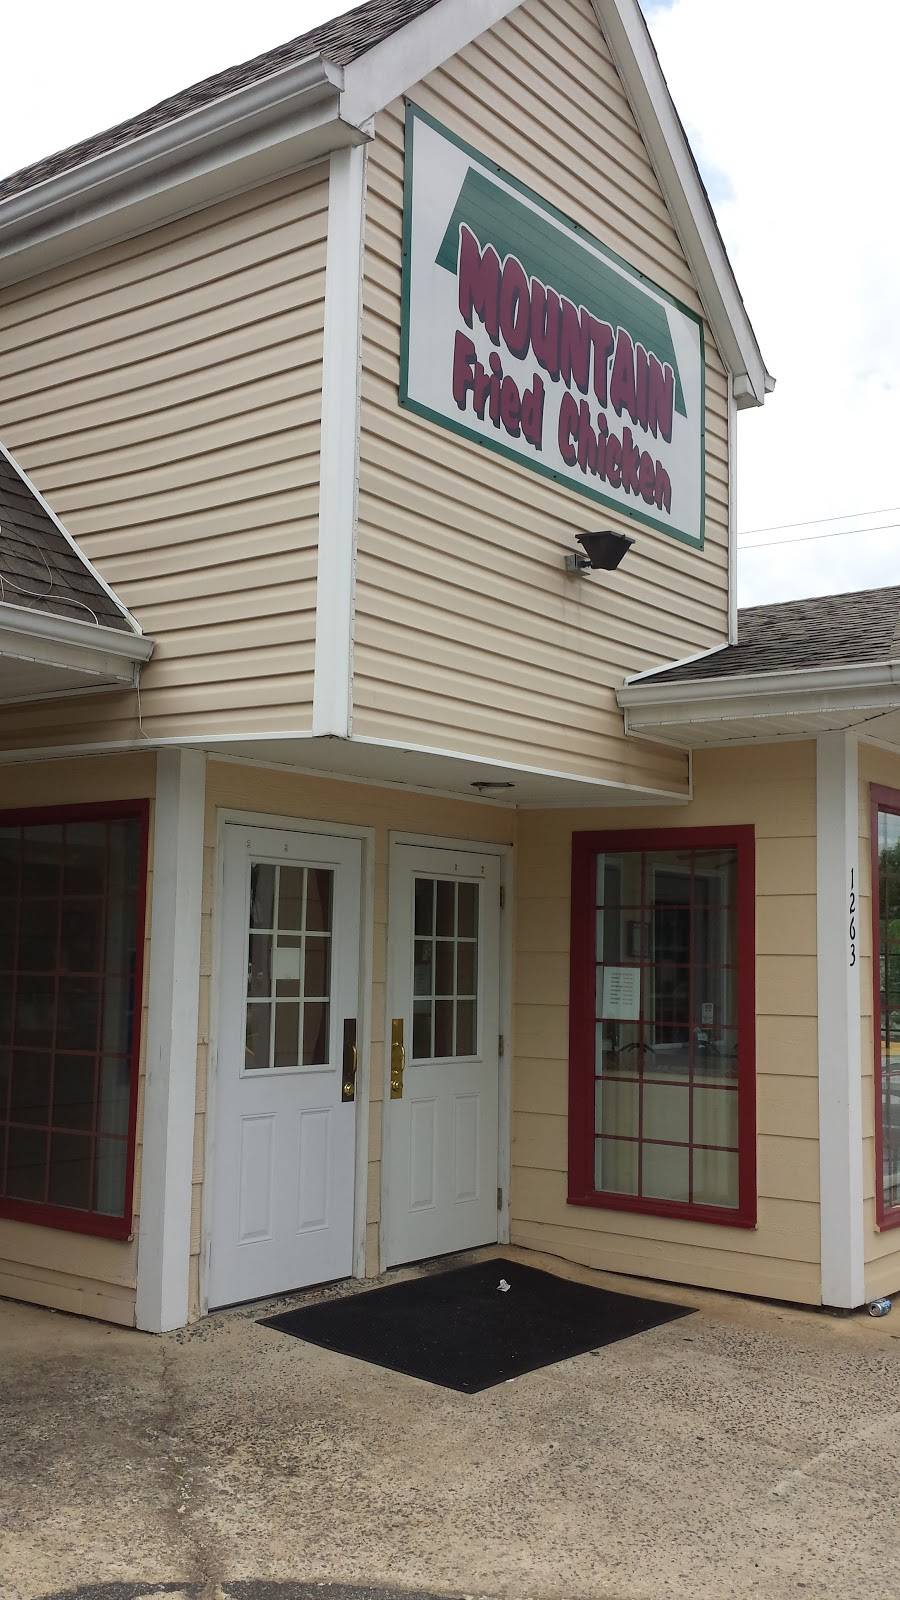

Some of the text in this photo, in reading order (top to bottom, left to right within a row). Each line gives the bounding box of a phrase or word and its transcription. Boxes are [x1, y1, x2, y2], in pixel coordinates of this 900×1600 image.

[453, 330, 671, 514] Fried Chicken
[458, 223, 674, 443] MOUNTAIN
